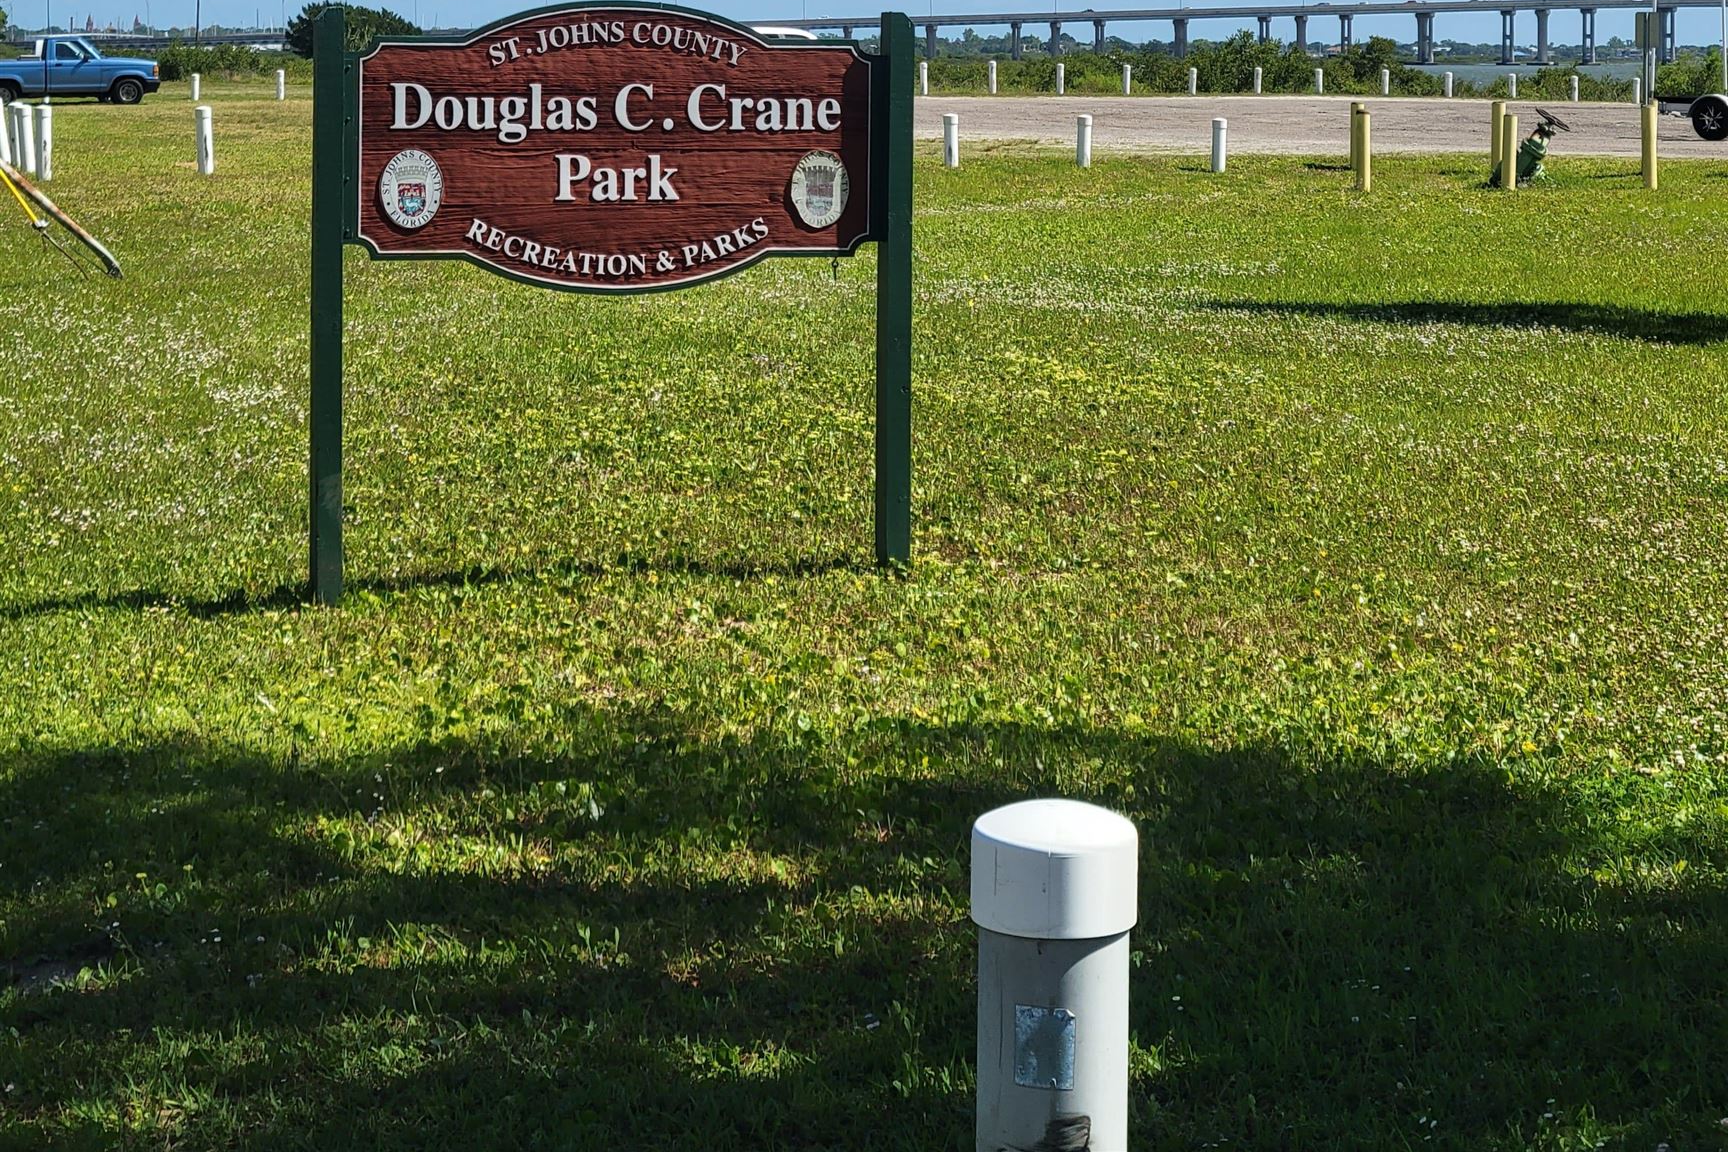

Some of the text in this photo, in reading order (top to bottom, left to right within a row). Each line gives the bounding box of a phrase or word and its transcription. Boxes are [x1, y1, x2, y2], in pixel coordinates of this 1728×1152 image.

[489, 21, 748, 67] ST. JOHNS COUNTY
[390, 83, 842, 143] Douglas C. Crane
[386, 151, 415, 176] JOHNS
[418, 153, 442, 193] COUNTY
[555, 154, 680, 201] Park
[390, 209, 435, 227] FLORIDA
[465, 216, 770, 276] RECREATION & PARKS
